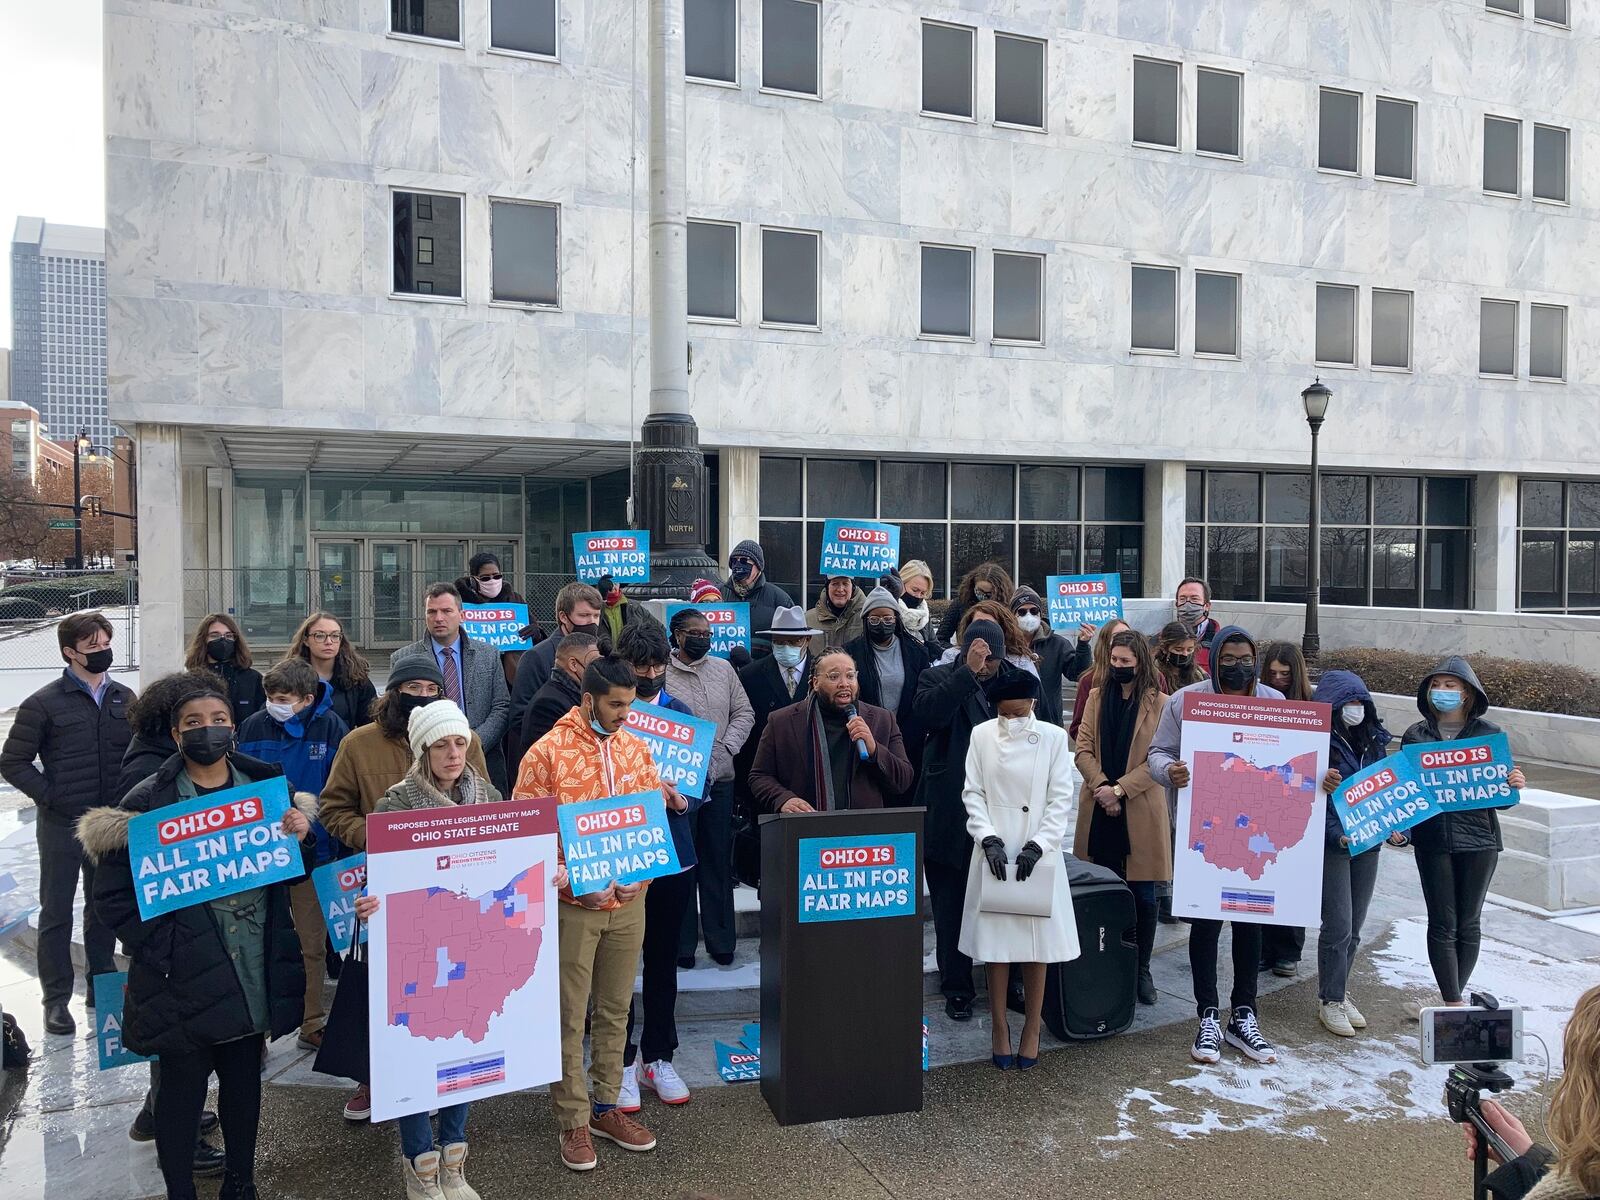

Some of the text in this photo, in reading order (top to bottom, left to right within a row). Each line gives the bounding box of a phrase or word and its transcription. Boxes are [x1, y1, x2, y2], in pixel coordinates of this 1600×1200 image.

[588, 538, 634, 550] OHIO IS
[839, 528, 887, 542] OHIO IS
[578, 552, 646, 566] ALL IN FOR
[824, 542, 896, 559] ALL IN FOR
[580, 566, 645, 580] FAIR MAPS
[824, 557, 856, 570] FAIR
[1060, 582, 1104, 593] OHIO IS
[1050, 596, 1118, 609] ALL IN FOR
[465, 610, 513, 620] OHIO IS
[719, 612, 732, 621] IS
[1052, 610, 1118, 623] FAIR MAPS
[464, 623, 477, 634] LL
[481, 624, 496, 634] IN
[719, 626, 746, 637] FOR
[1212, 710, 1240, 719] HOUSE
[1254, 713, 1323, 726] REPRESENTATIVES
[1247, 705, 1282, 713] LEGISLATIVE
[627, 711, 690, 740] OHIO IS
[667, 744, 704, 768] FOR
[1422, 748, 1488, 766] OHIO IS
[1420, 764, 1508, 787] LL IN FOR
[1346, 772, 1393, 803] OHIO IS
[1435, 783, 1511, 803] IR MAPS
[1344, 781, 1421, 830] ALL IN FOR
[161, 800, 257, 840] OHIO IS
[388, 809, 540, 831] PROPOSED STATE LEGISLATIVE UNITY MAPS
[577, 808, 642, 832] OHIO IS
[1350, 797, 1430, 847] FAIR MAPS
[412, 822, 520, 842] OHIO STATE SENATE
[138, 822, 289, 879] ALL IN FOR
[568, 827, 666, 861] ALL IN FOR
[822, 848, 890, 865] OHIO IS
[143, 847, 291, 905] FAIR MAPS
[571, 849, 670, 884] FAIR MAPS
[340, 867, 366, 886] OH
[803, 868, 909, 891] ALL IN FOR
[329, 894, 357, 919] AL
[804, 889, 908, 912] FAIR MAPS
[722, 1065, 753, 1074] ALL
